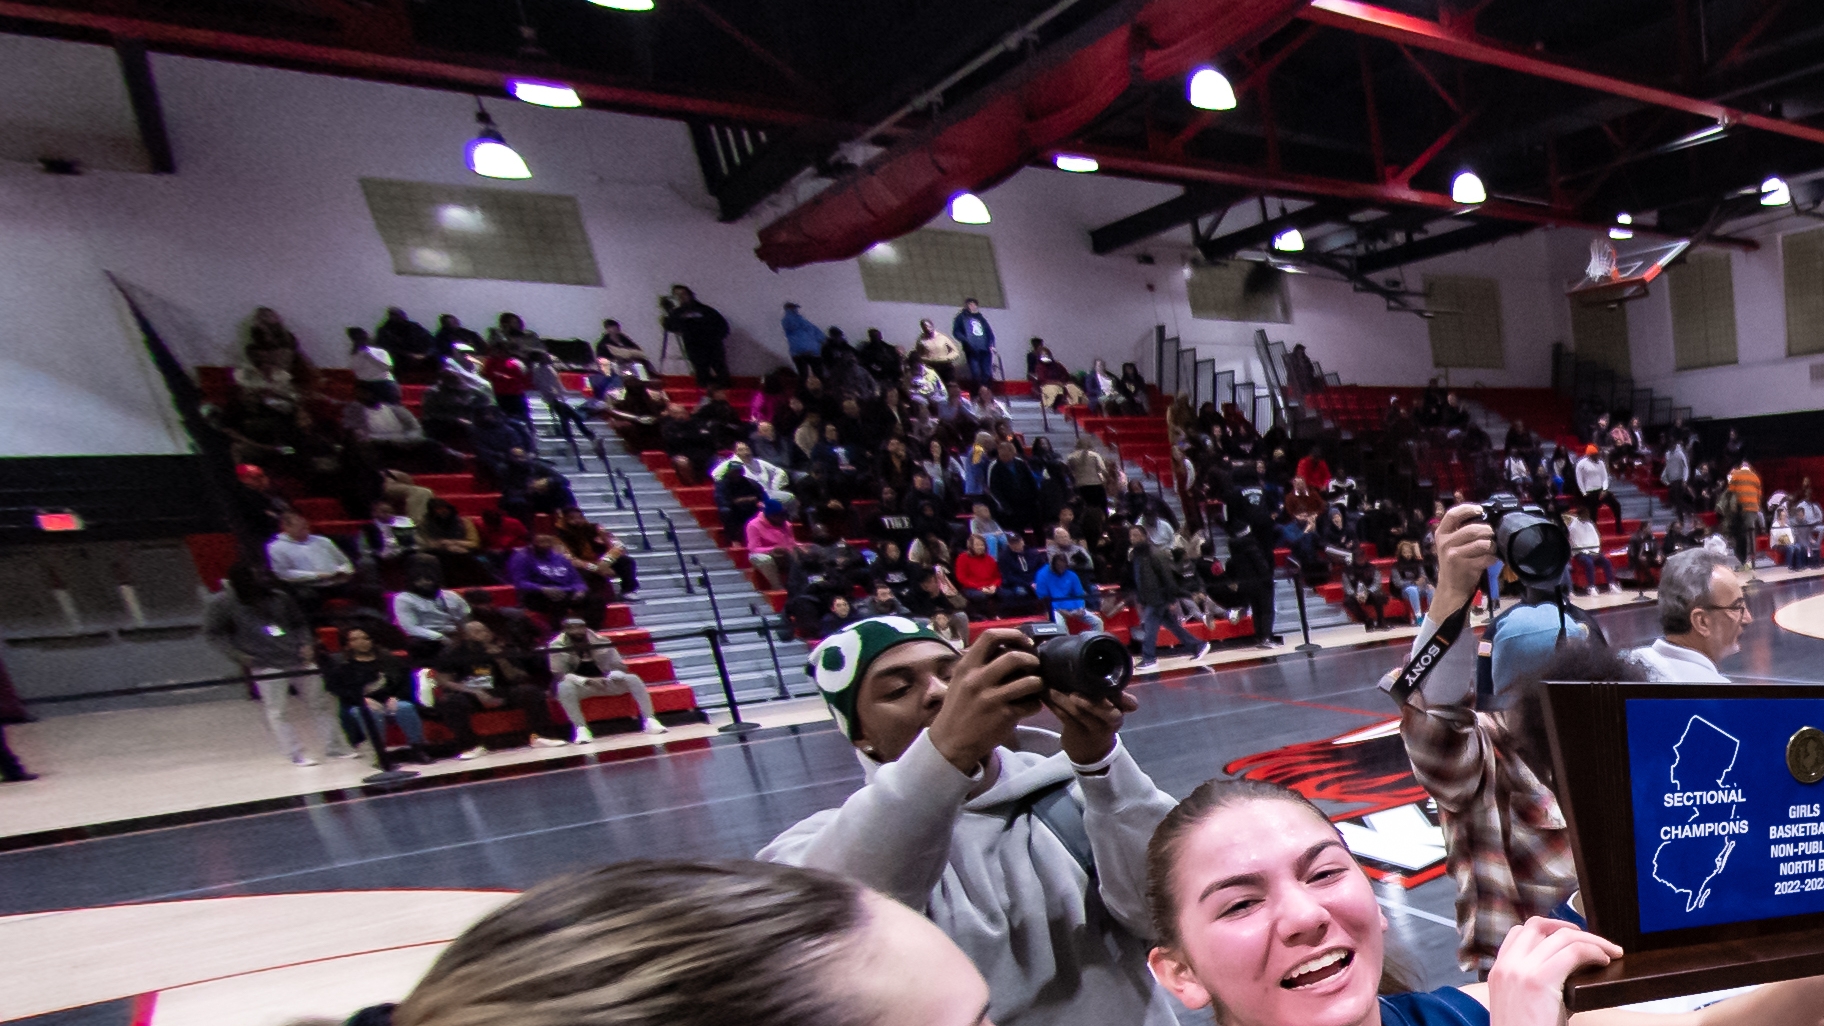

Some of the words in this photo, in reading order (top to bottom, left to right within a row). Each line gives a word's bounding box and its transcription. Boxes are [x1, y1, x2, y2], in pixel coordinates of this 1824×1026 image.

[1405, 644, 1440, 687] SONY
[1663, 789, 1746, 807] SECTIONAL
[1788, 803, 1821, 819] GIRLS
[1660, 820, 1749, 840] CHAMPIONS
[1779, 859, 1816, 875] NORTH
